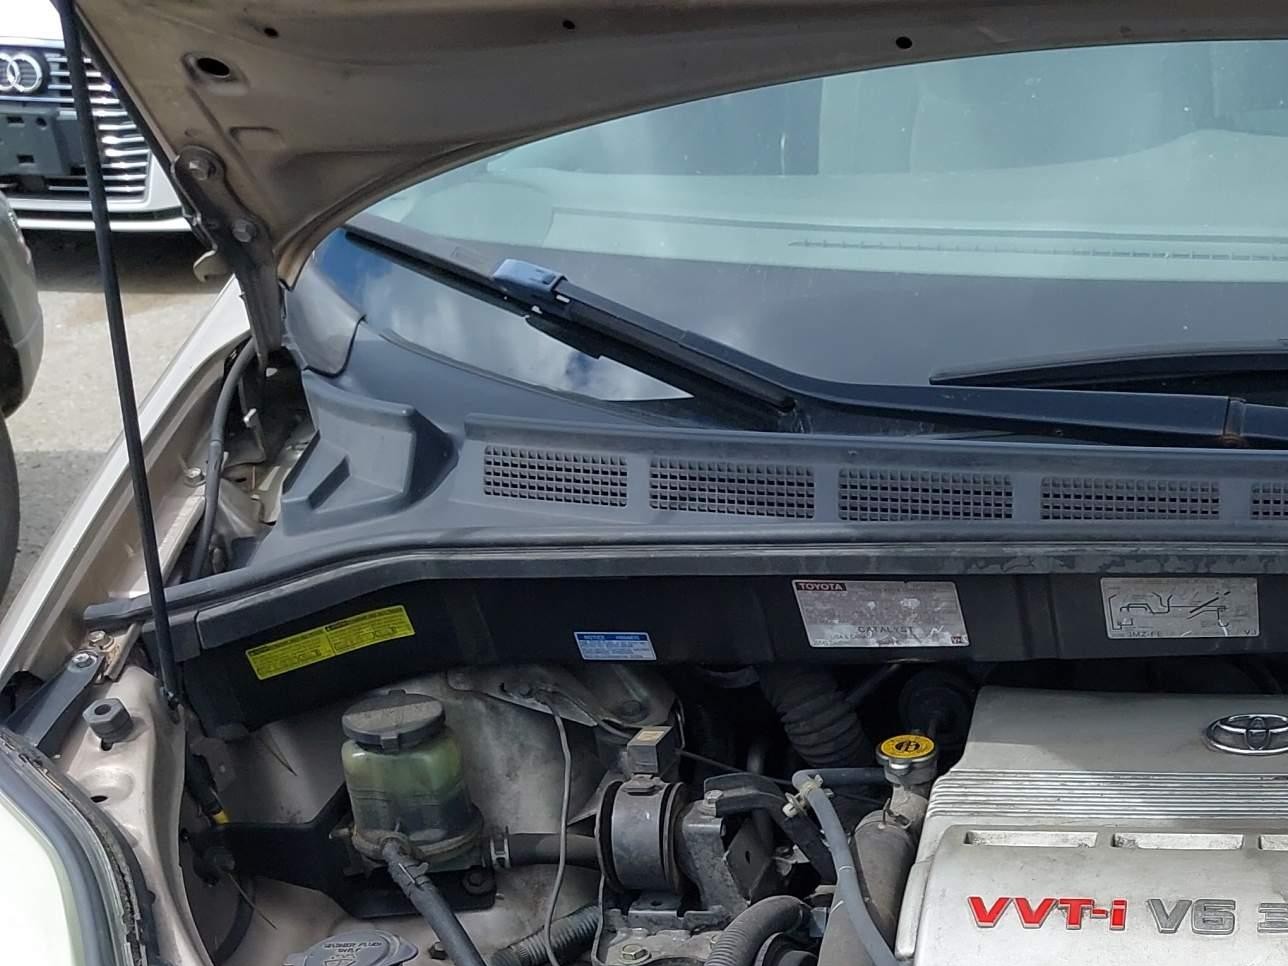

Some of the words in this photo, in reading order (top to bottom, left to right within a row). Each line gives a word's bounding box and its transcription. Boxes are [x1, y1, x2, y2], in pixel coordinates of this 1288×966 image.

[798, 582, 843, 591] TOYOTA
[857, 625, 914, 634] CATALYST
[966, 895, 1129, 931] VVT-i
[1146, 897, 1237, 936] V6
